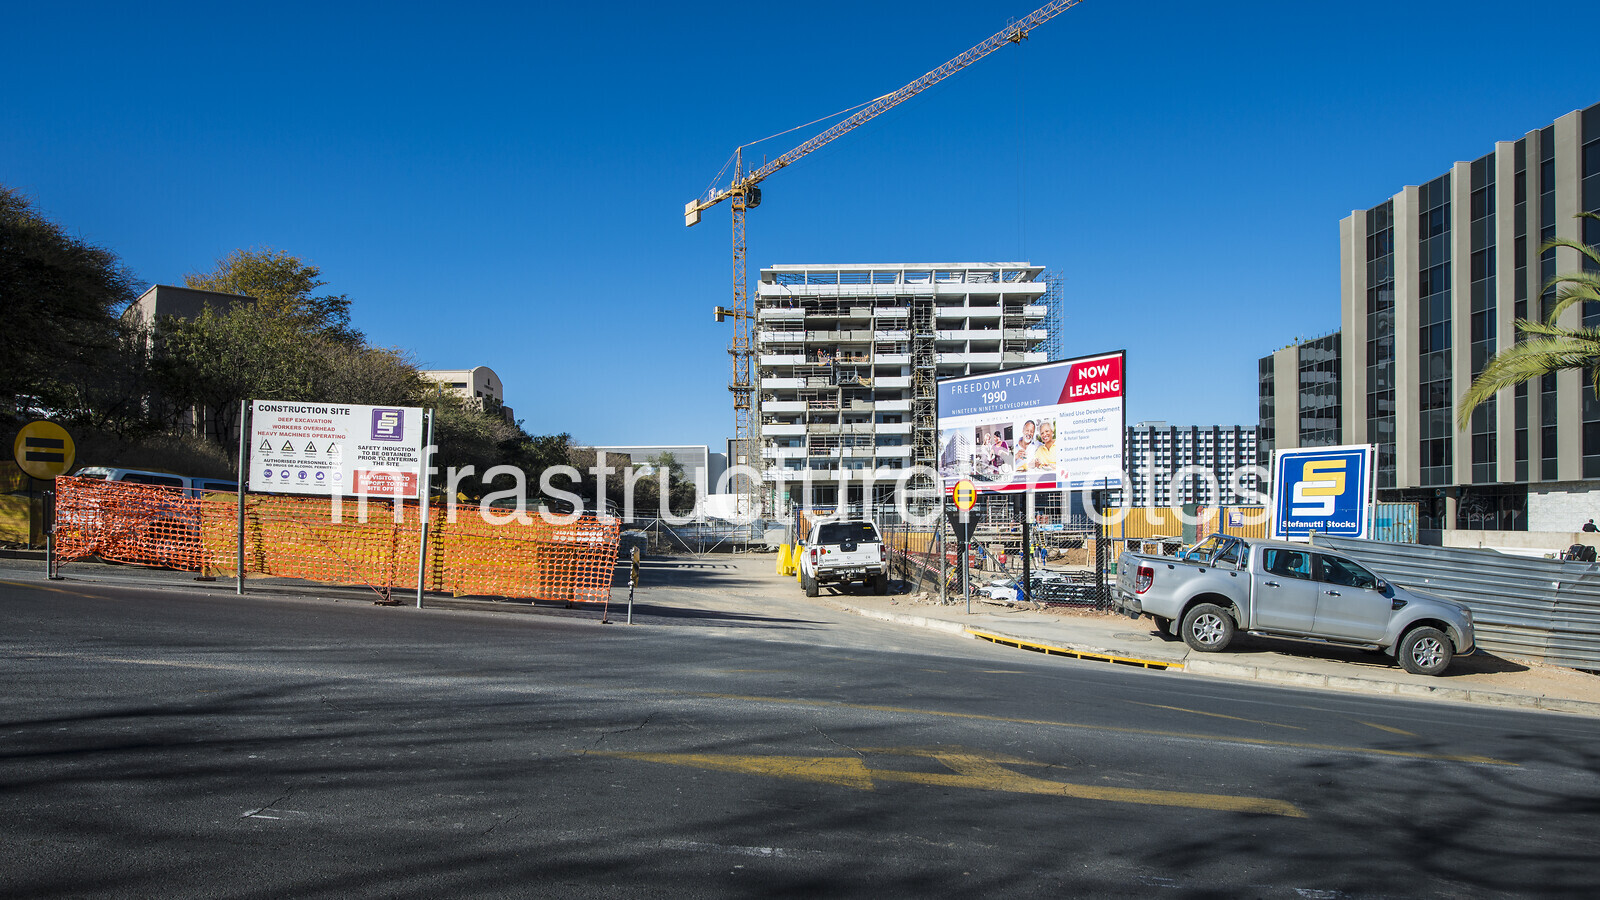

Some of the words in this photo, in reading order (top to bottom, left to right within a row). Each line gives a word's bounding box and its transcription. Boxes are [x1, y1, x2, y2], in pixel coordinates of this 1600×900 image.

[1079, 364, 1110, 380] NOW
[951, 380, 1000, 395] FREEDOM
[1006, 373, 1040, 387] PLAZA
[1070, 380, 1120, 398] LEASING
[981, 390, 1007, 404] 1990
[258, 404, 328, 414] CONSTRUCTION
[951, 407, 977, 415] NINETEEN
[999, 400, 1040, 409] DEVELOPMENT
[1085, 406, 1120, 415] Development
